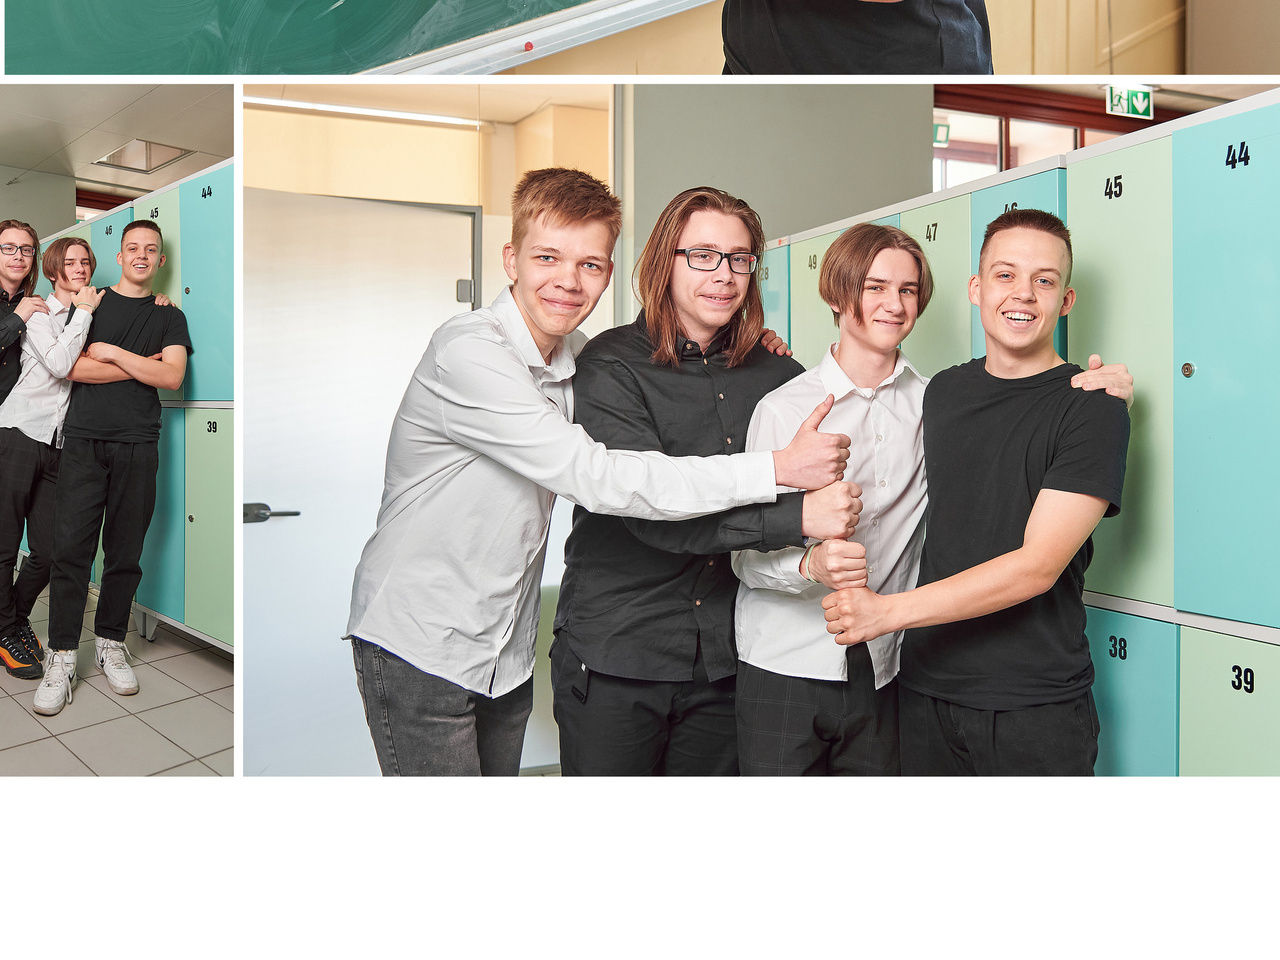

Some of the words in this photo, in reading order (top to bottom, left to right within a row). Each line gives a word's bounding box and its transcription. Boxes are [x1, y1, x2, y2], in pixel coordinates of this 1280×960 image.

[1225, 140, 1250, 169] 44
[201, 185, 212, 199] 44
[1104, 175, 1123, 199] 45
[150, 207, 159, 219] 45
[925, 223, 938, 242] 47
[808, 254, 817, 270] 49
[207, 421, 217, 433] 39
[1109, 636, 1127, 660] 38
[1231, 665, 1255, 693] 39
